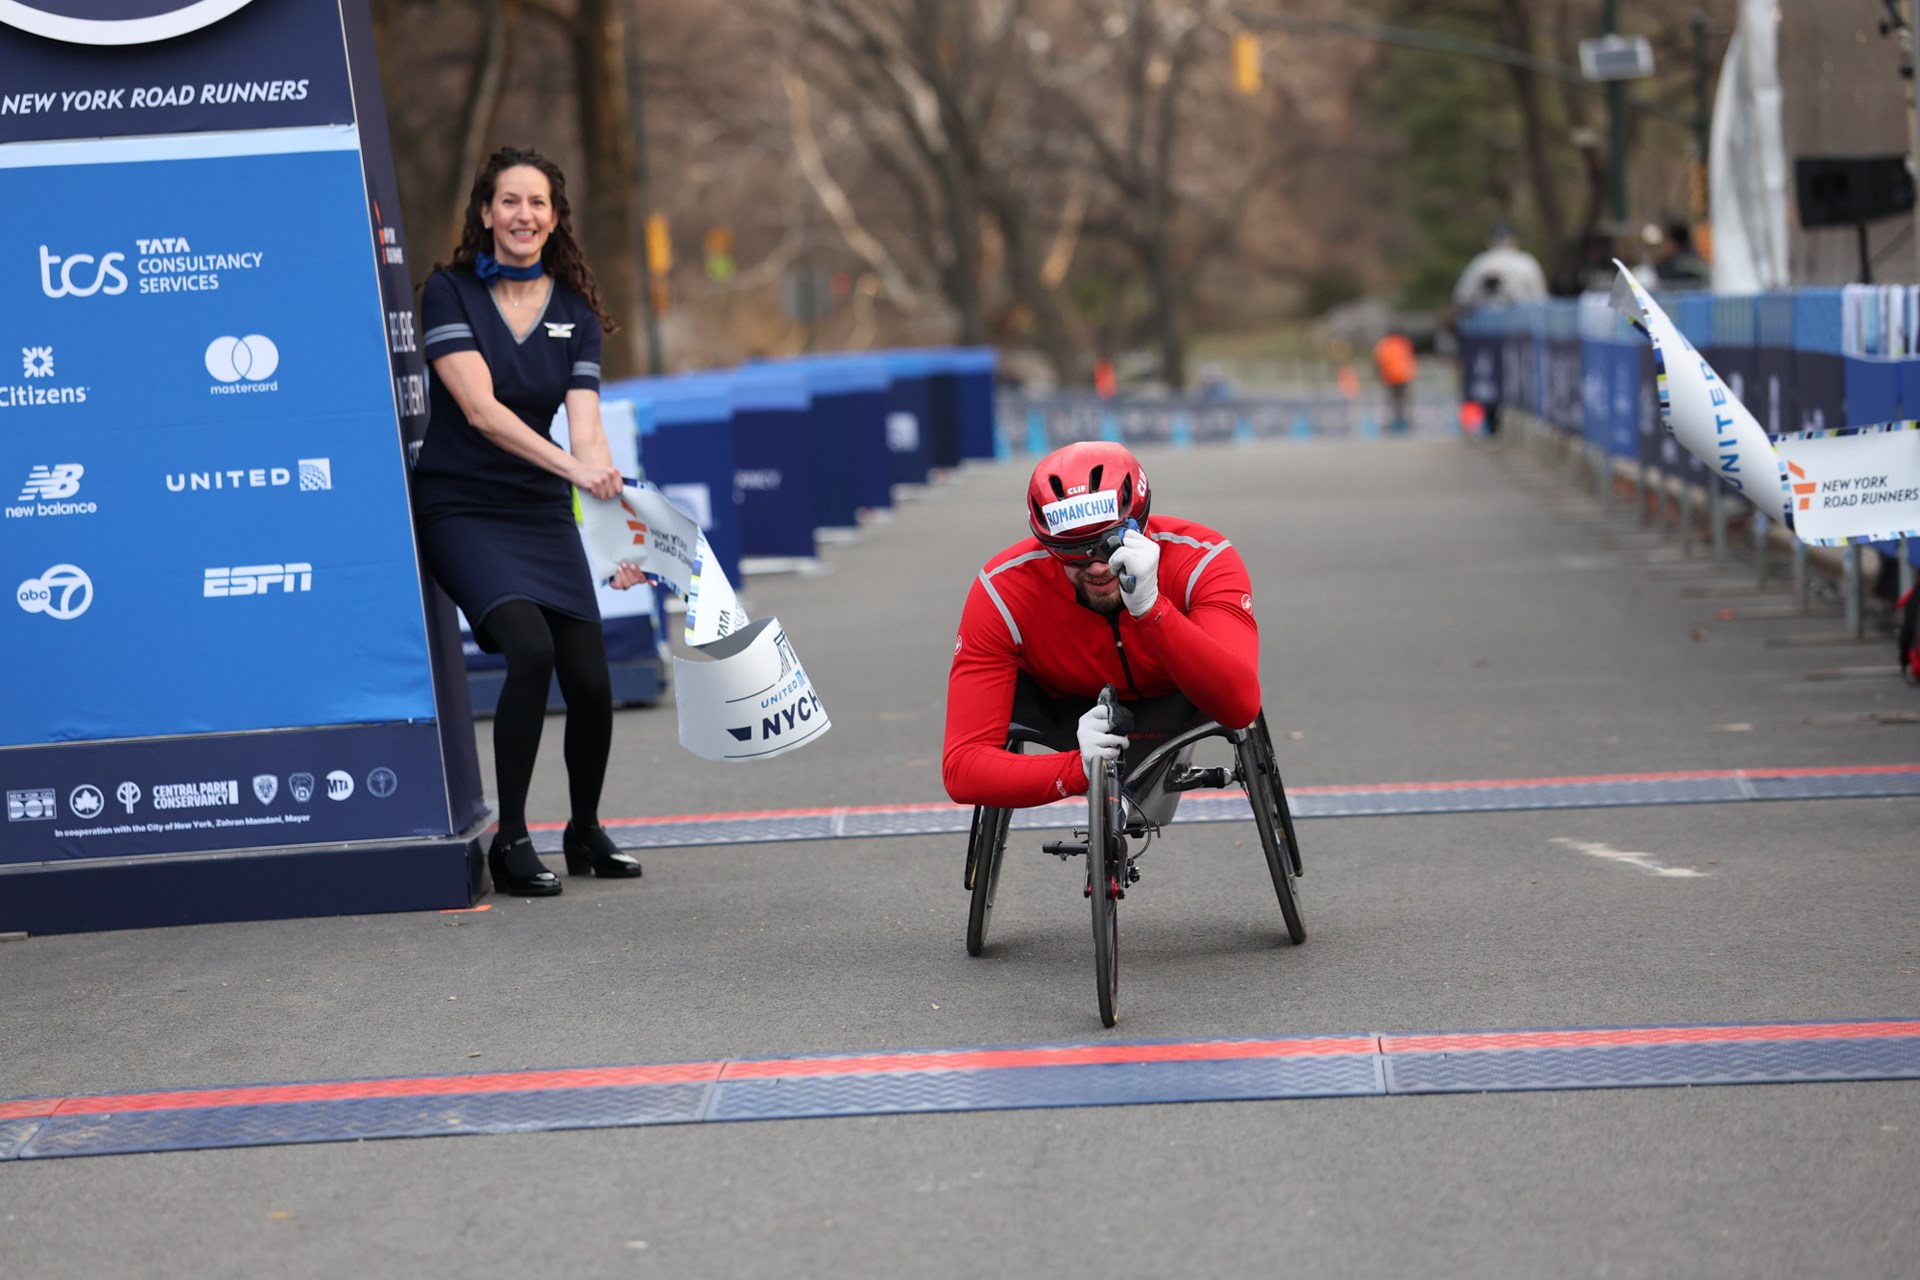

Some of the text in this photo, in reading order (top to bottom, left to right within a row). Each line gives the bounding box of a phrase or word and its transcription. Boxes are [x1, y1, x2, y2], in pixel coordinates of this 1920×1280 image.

[0, 79, 309, 115] NEW YORK ROAD RUNNERS
[136, 237, 191, 255] TATA
[39, 245, 128, 298] tcs
[137, 251, 263, 274] CONSULTANCY
[139, 273, 219, 294] SERVICES
[0, 385, 88, 407] Citizens
[210, 380, 278, 395] mastercard
[166, 467, 291, 492] UNITED
[1067, 484, 1087, 495] CLIF
[1822, 475, 1889, 493] NEW YORK
[1823, 487, 1919, 509] ROAD RUNNERS
[5, 500, 98, 519] new balance
[1045, 498, 1116, 527] ROMANCHUK
[654, 539, 677, 557] ROAD
[203, 562, 312, 598] ESPN
[20, 589, 48, 601] abc
[717, 609, 731, 638] TATA
[760, 679, 798, 709] UNITED
[153, 780, 228, 798] CENTRAL PARK
[328, 779, 349, 794] MTA
[10, 798, 54, 819] DOT
[153, 793, 228, 810] CONSERVANCY
[55, 814, 311, 838] In cooperation with the City of New York, Zohran Mamdani, Mayor
